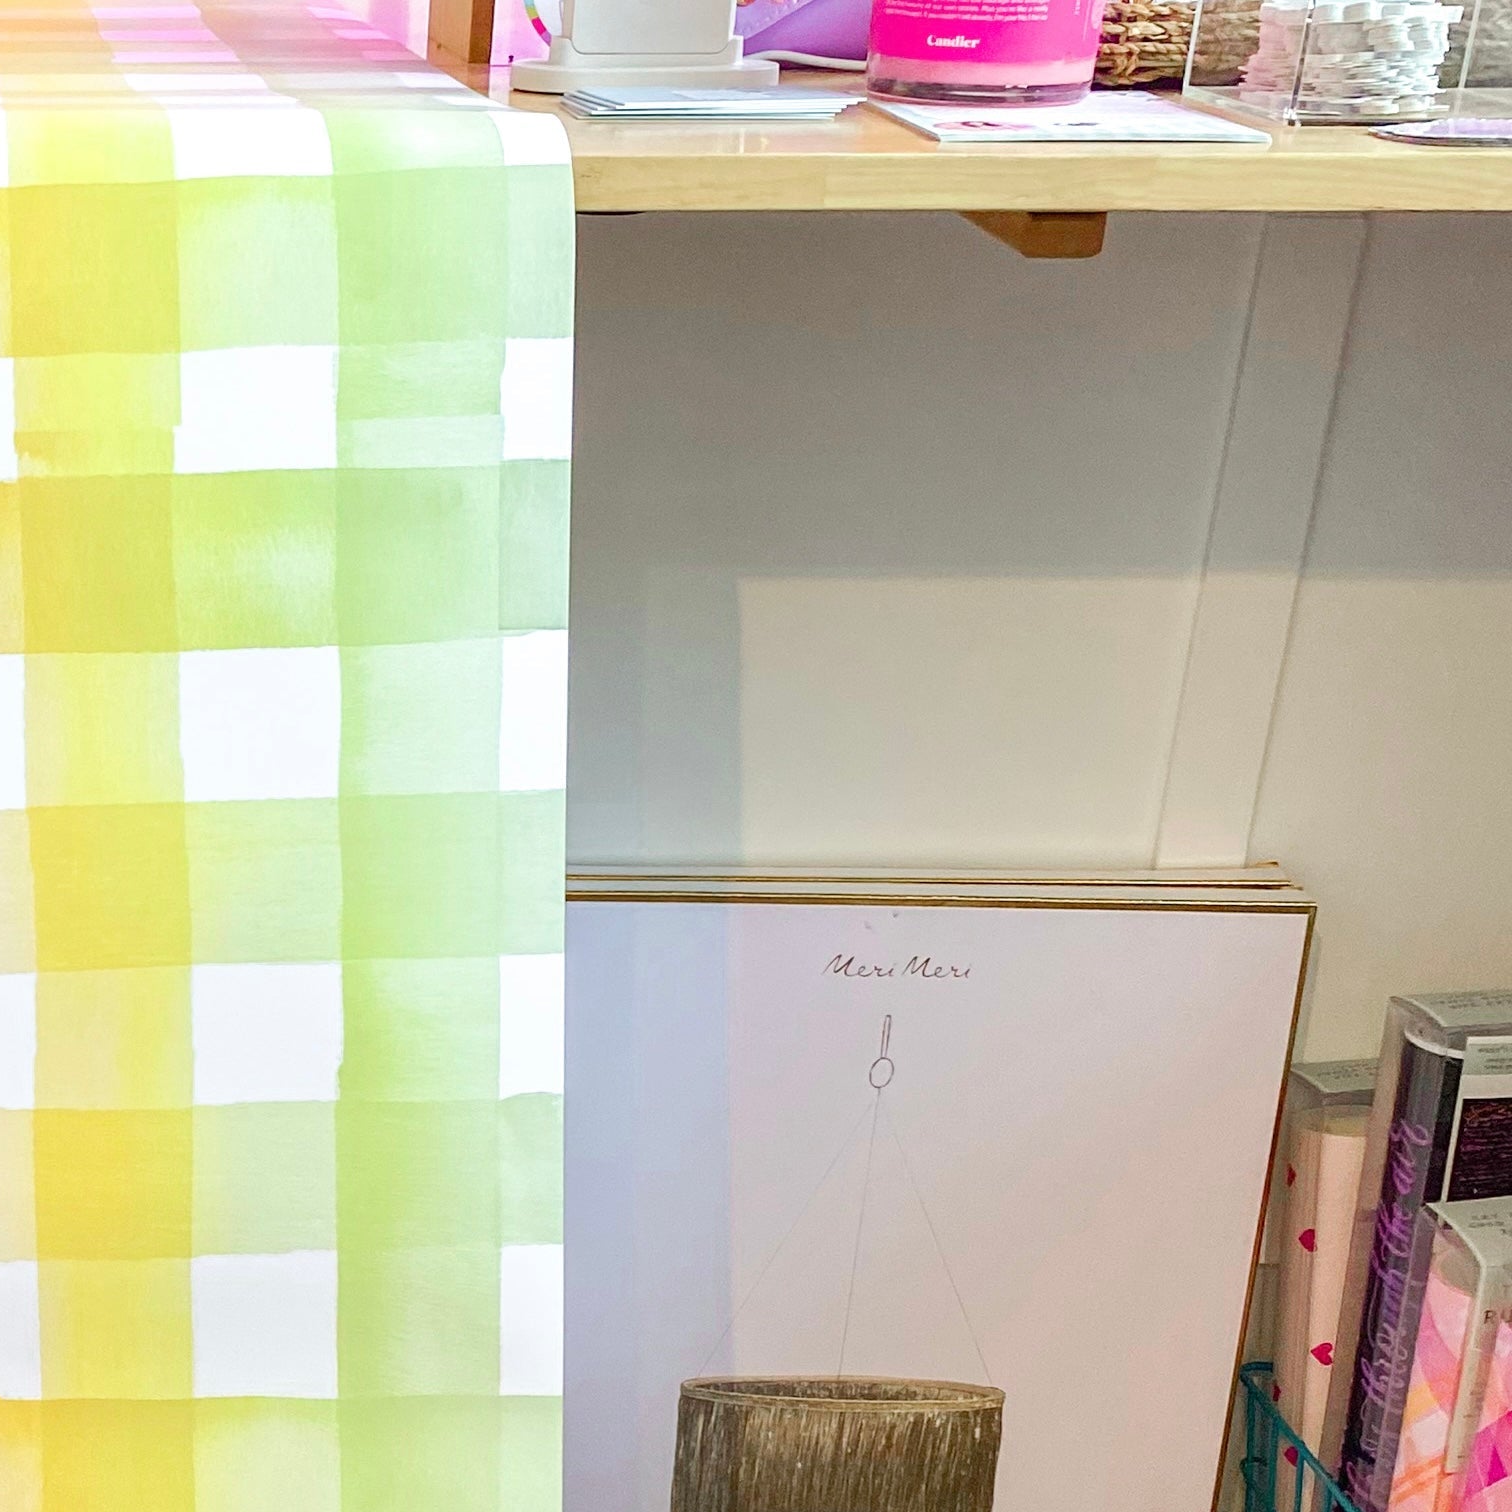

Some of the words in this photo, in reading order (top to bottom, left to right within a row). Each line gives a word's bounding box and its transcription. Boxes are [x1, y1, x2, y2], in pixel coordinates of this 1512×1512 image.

[926, 34, 981, 49] Candier
[822, 953, 896, 979] Meri
[901, 954, 972, 979] Meri
